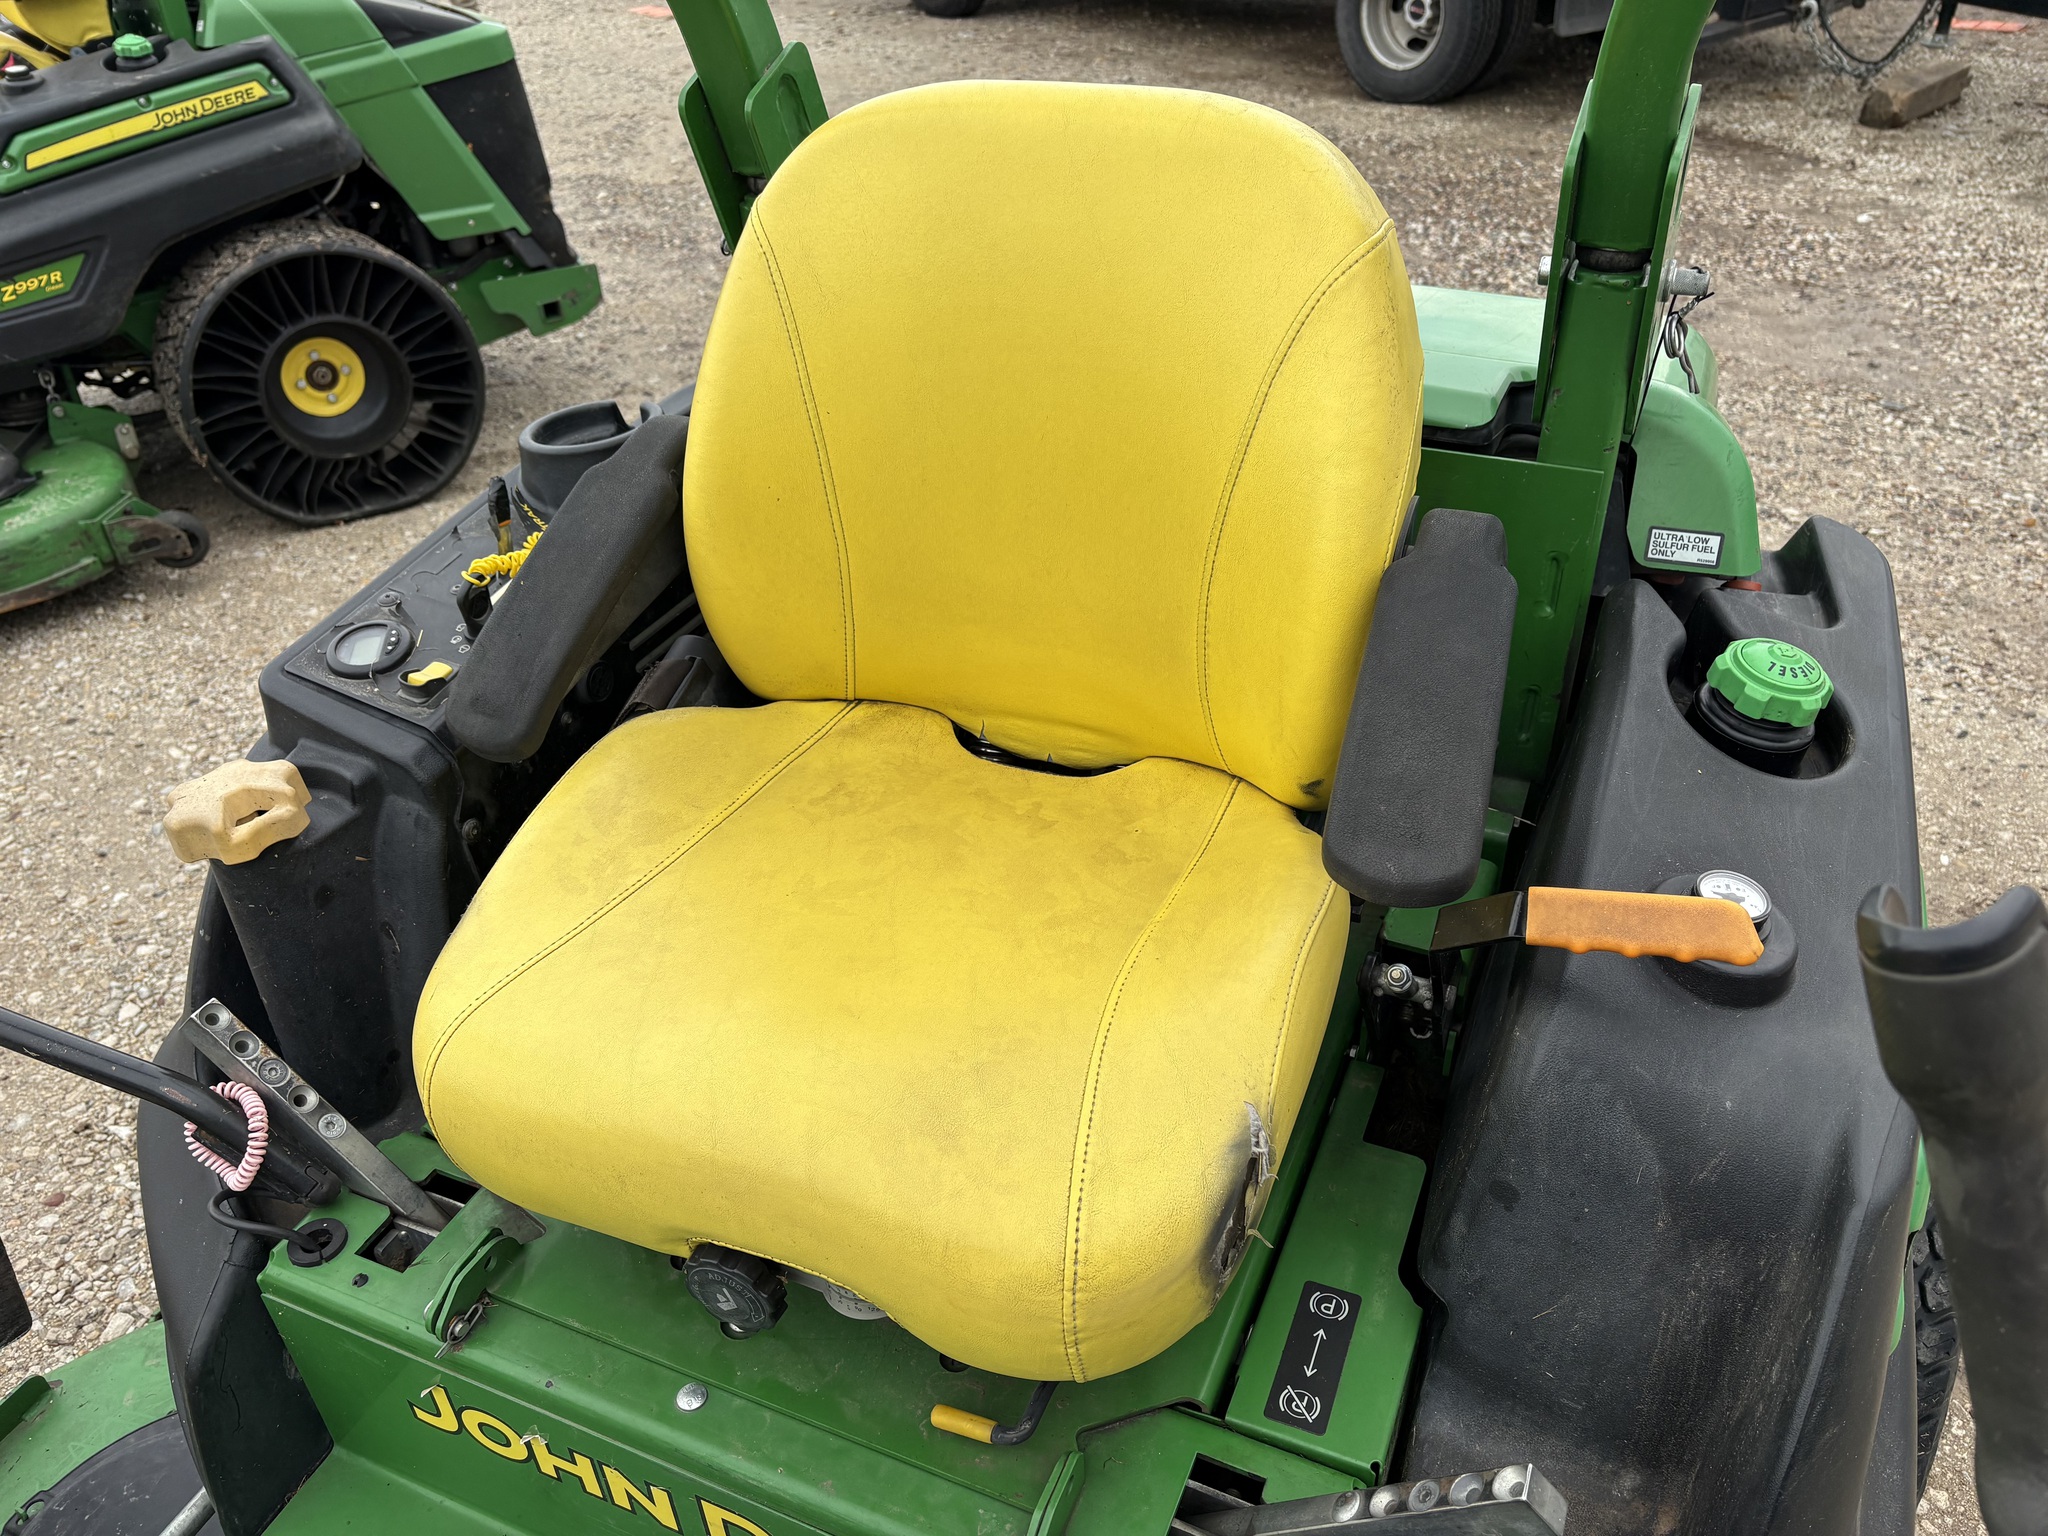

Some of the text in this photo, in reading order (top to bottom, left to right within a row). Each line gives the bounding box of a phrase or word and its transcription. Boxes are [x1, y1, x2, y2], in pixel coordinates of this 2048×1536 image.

[152, 86, 257, 129] JOHN DEERE
[0, 270, 63, 303] Z997R
[1651, 540, 1716, 555] SULFUR FUEL
[1653, 531, 1711, 545] ULTRA LOW
[1650, 548, 1677, 558] ONLY
[1767, 660, 1816, 679] DIESEL
[407, 1384, 684, 1536] JOHN
